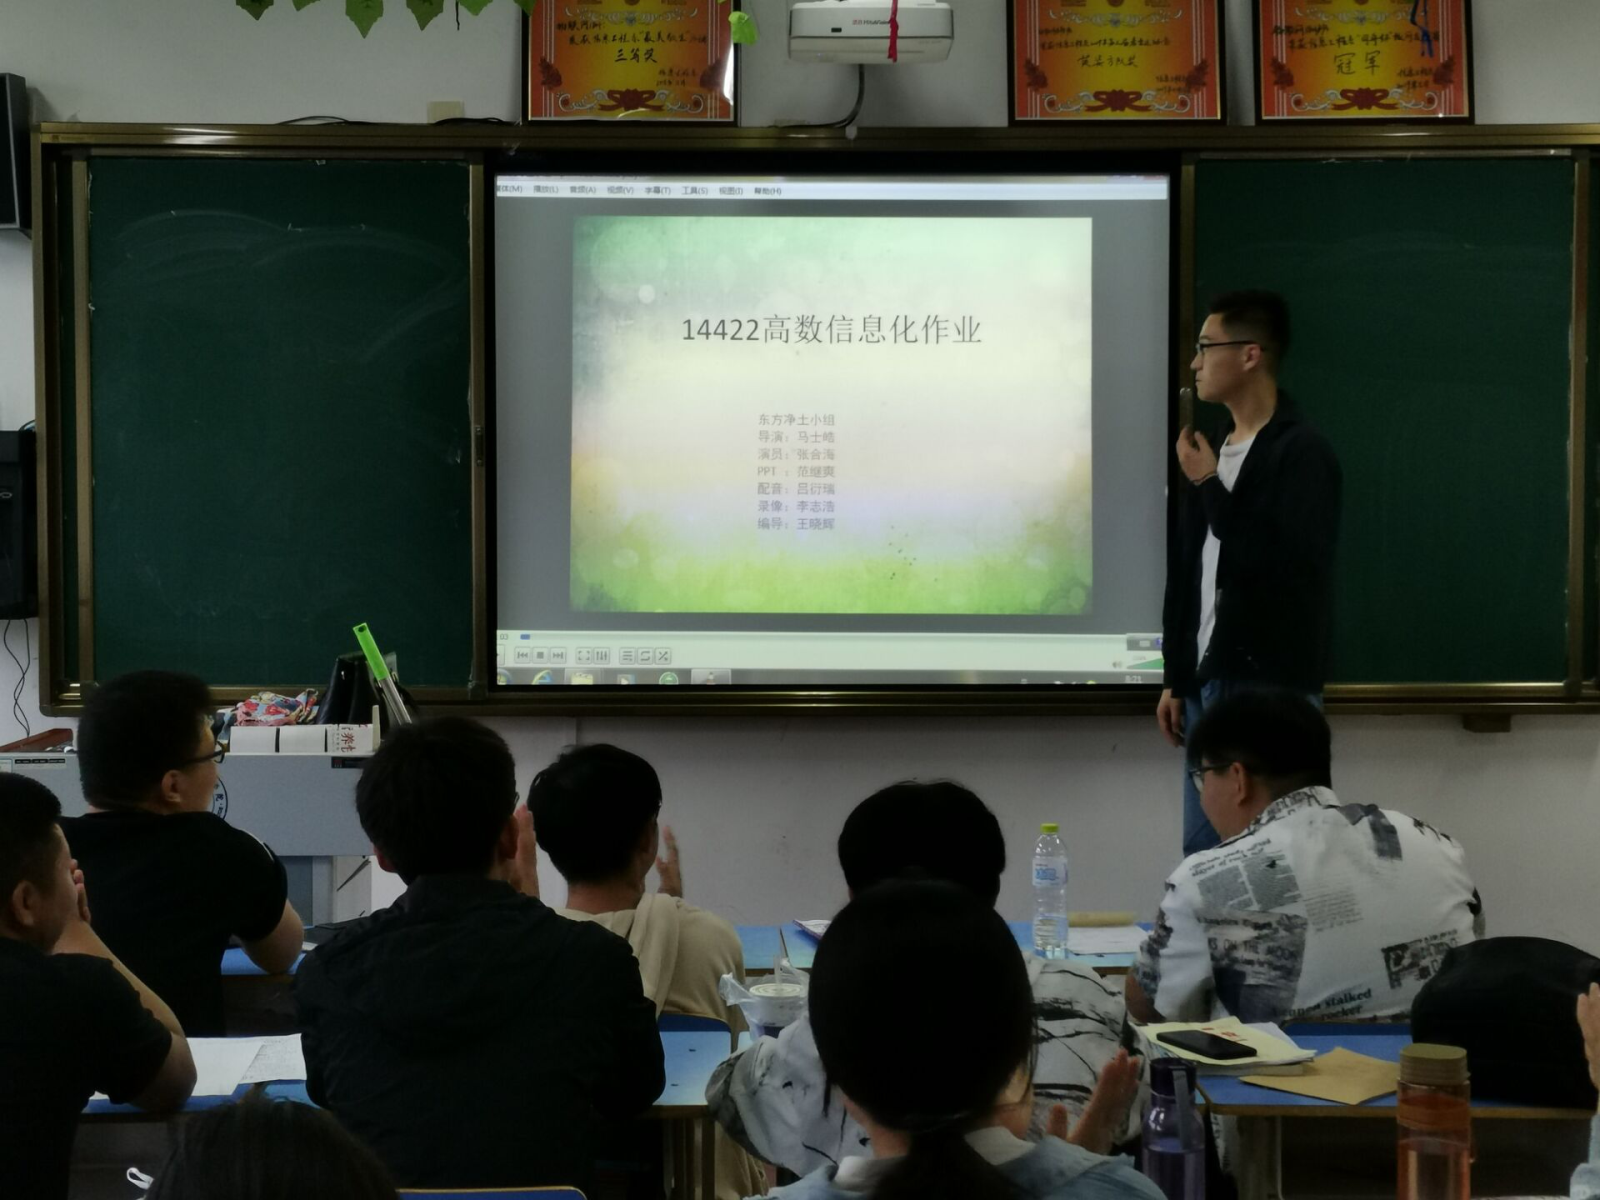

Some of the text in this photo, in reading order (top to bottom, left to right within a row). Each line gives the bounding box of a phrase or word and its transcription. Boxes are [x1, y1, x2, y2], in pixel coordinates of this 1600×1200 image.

[1333, 50, 1381, 75] 冠军
[682, 314, 982, 345] 14422高数信息化作业
[758, 413, 835, 427] 东方净土小组
